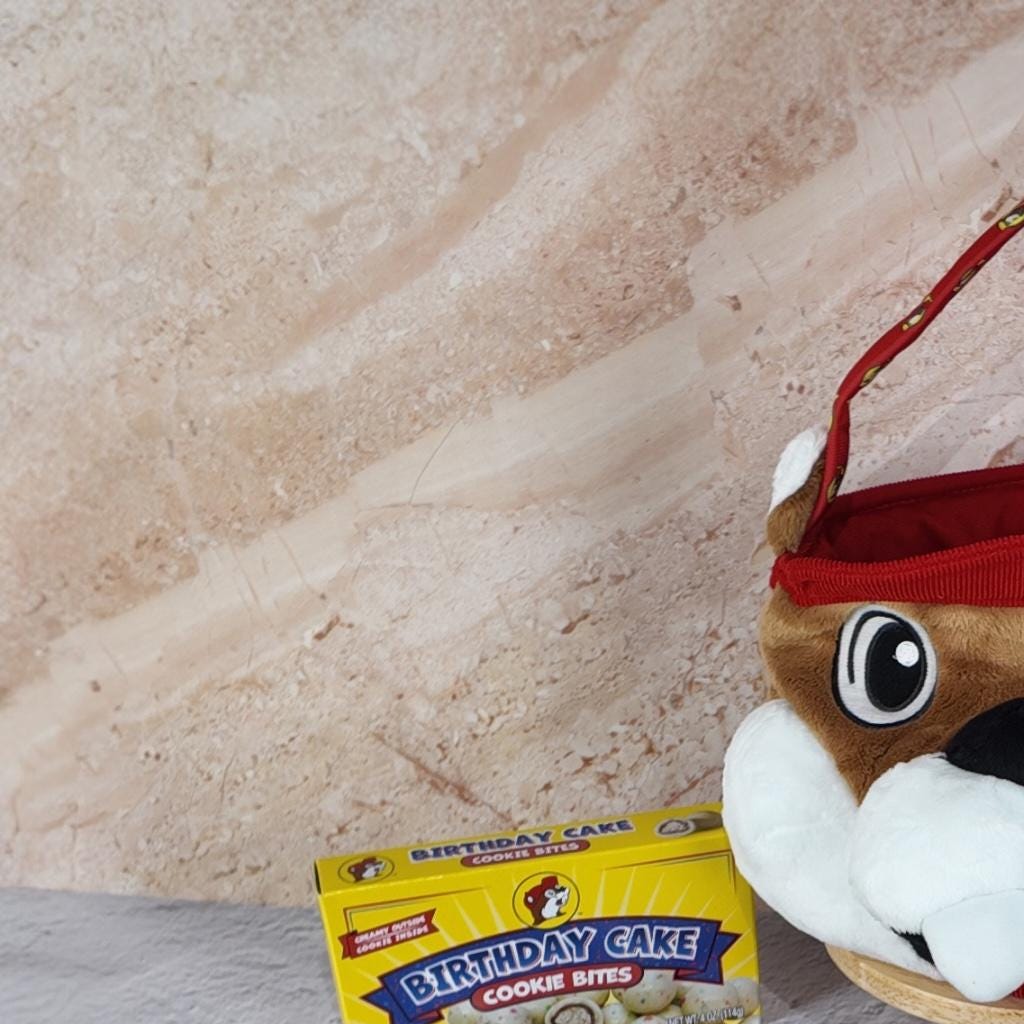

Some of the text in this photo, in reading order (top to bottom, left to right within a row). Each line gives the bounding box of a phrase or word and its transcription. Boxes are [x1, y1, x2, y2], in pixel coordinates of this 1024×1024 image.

[411, 820, 633, 861] BIRTHDAY CAKE
[472, 843, 579, 864] COOKIE BITES
[401, 925, 700, 1005] BIRTHDAY CAKE
[483, 966, 632, 1005] COOKIE BITES
